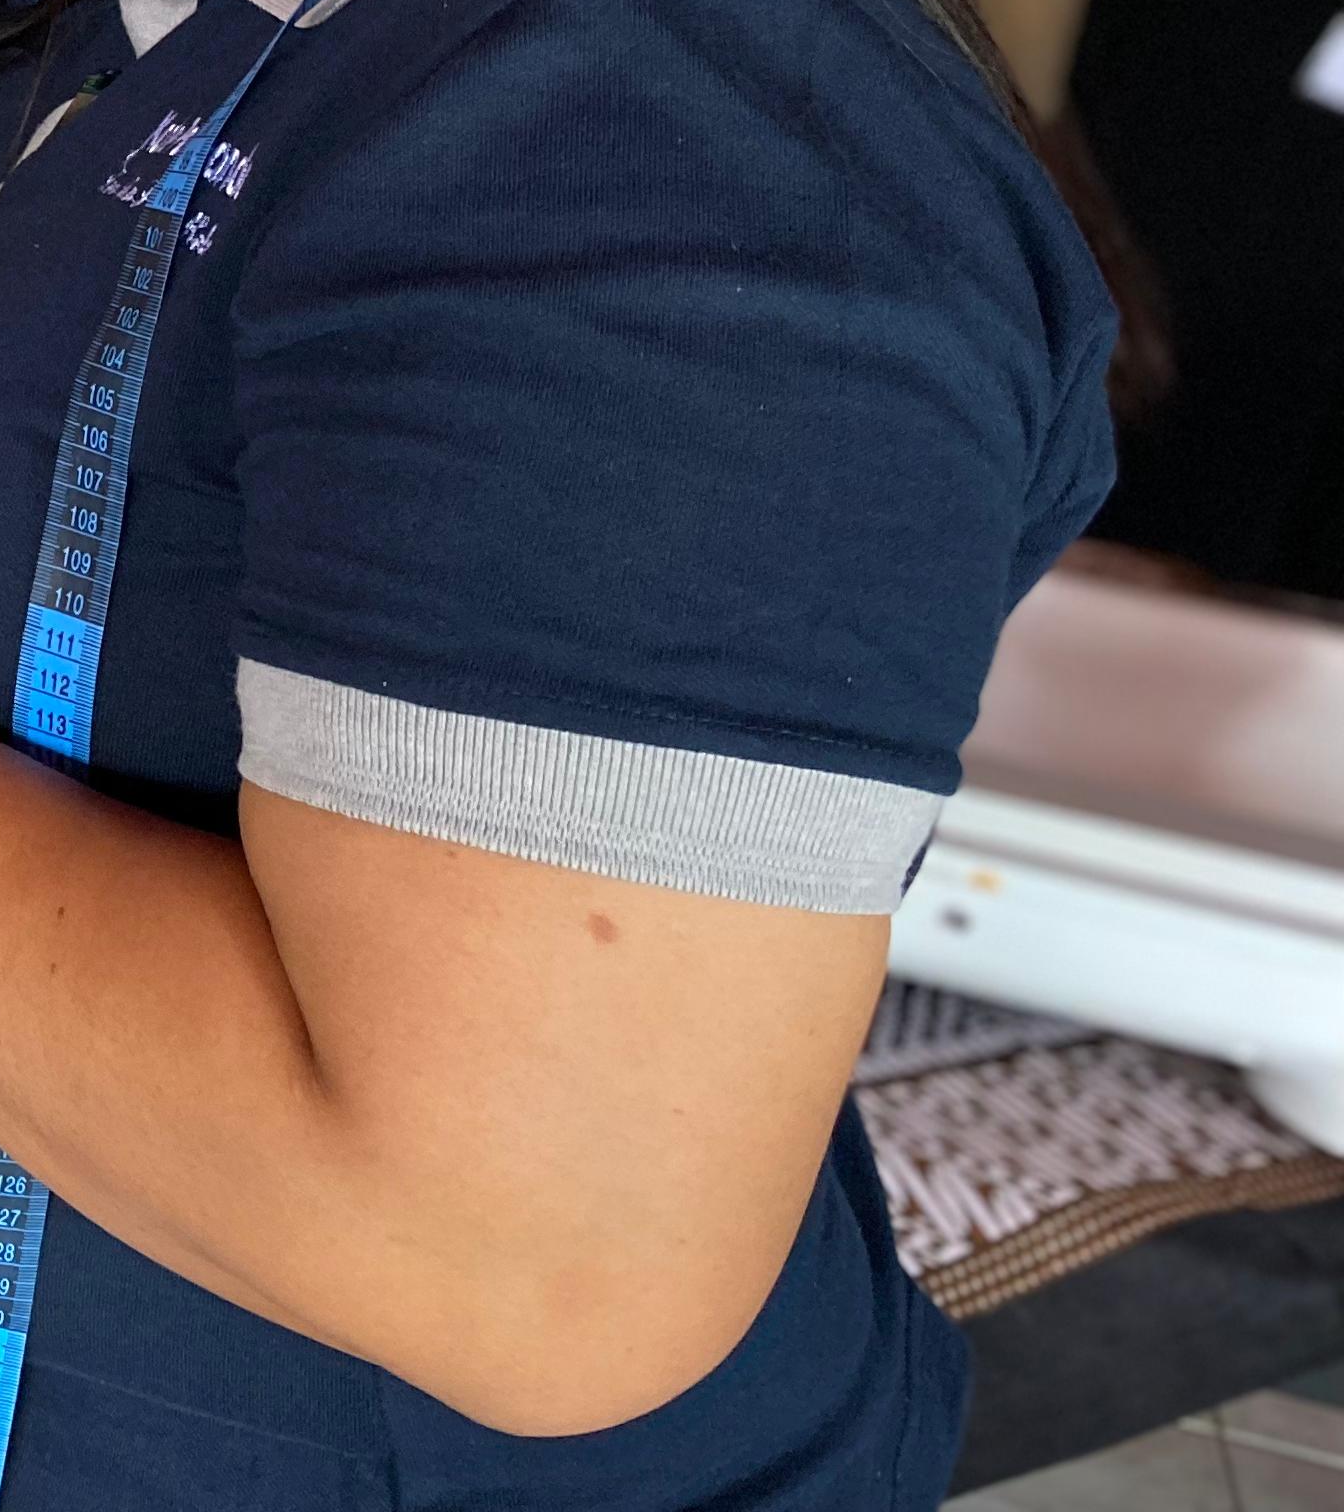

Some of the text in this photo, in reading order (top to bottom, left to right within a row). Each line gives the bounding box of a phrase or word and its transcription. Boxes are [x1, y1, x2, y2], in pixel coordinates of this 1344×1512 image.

[144, 226, 165, 249] 101
[131, 266, 153, 290] 102
[115, 305, 141, 329] 103
[99, 342, 127, 370] 104
[88, 383, 115, 411] 105
[82, 424, 108, 452] 106
[75, 464, 104, 492] 107
[69, 505, 98, 534] 108
[62, 546, 92, 575] 109
[54, 587, 85, 617] 110
[46, 627, 75, 657] 111
[40, 668, 71, 697] 112
[36, 708, 67, 736] 113
